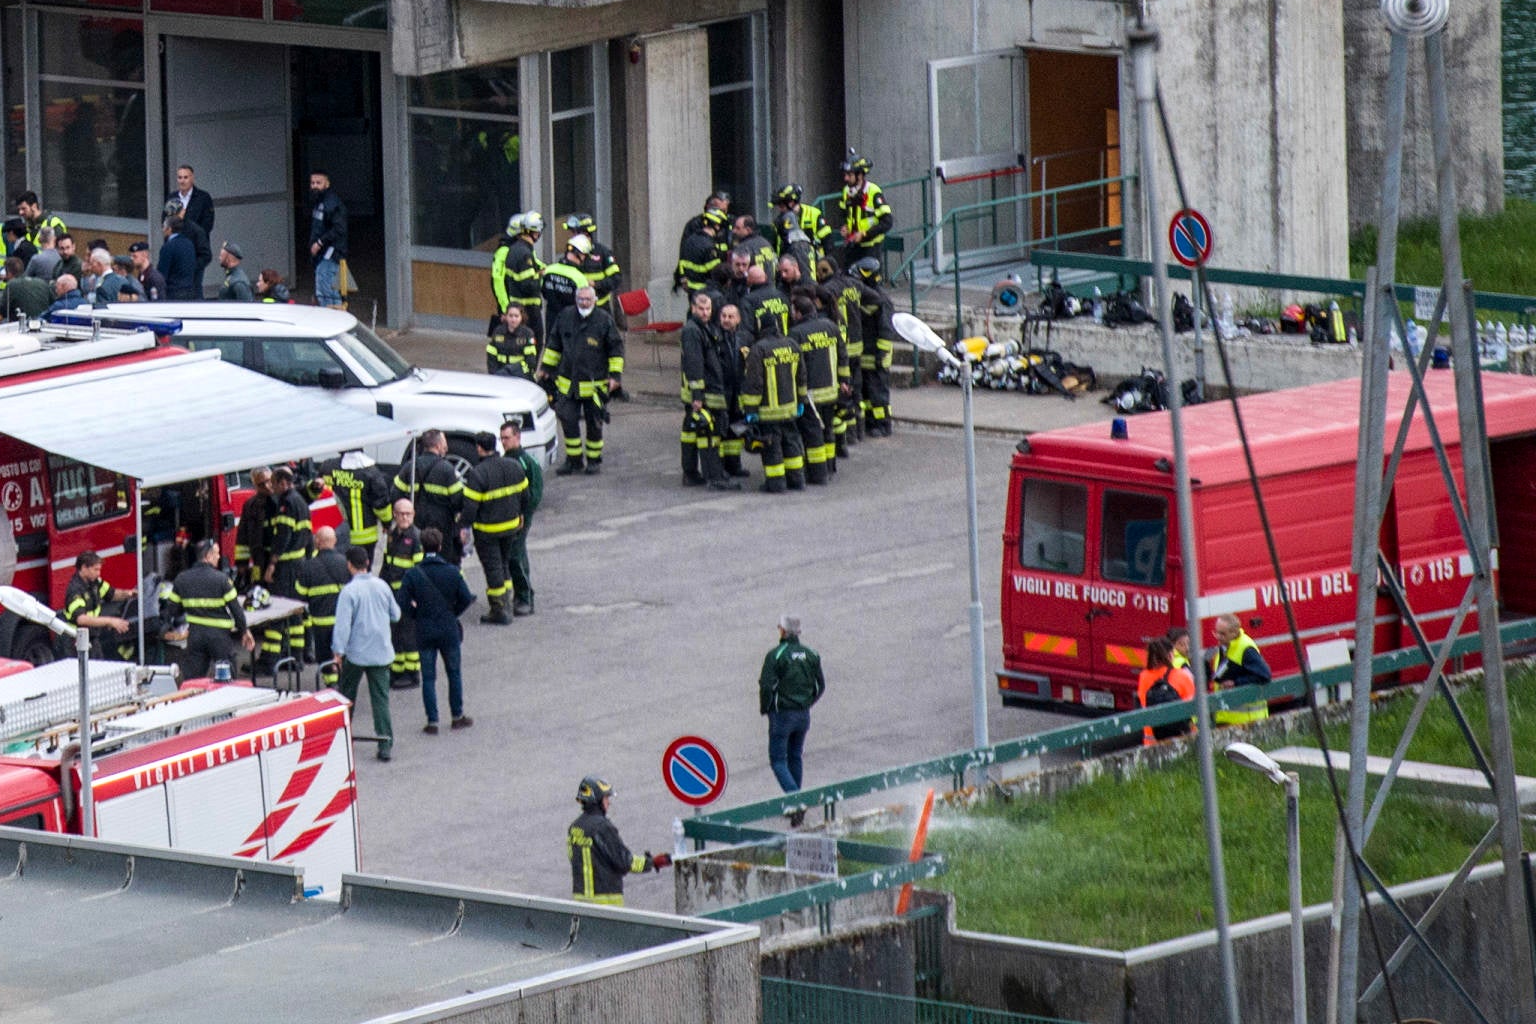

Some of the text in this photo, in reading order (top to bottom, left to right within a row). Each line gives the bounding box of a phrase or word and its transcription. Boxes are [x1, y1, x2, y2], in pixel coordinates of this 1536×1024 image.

[1014, 575, 1169, 613] VIGILI DEL FUOCO 115
[1261, 578, 1312, 607] VIGILI
[1321, 571, 1352, 597] DEL
[1429, 558, 1454, 582] 115
[133, 723, 305, 790] VIGILI DEL FUOCO
